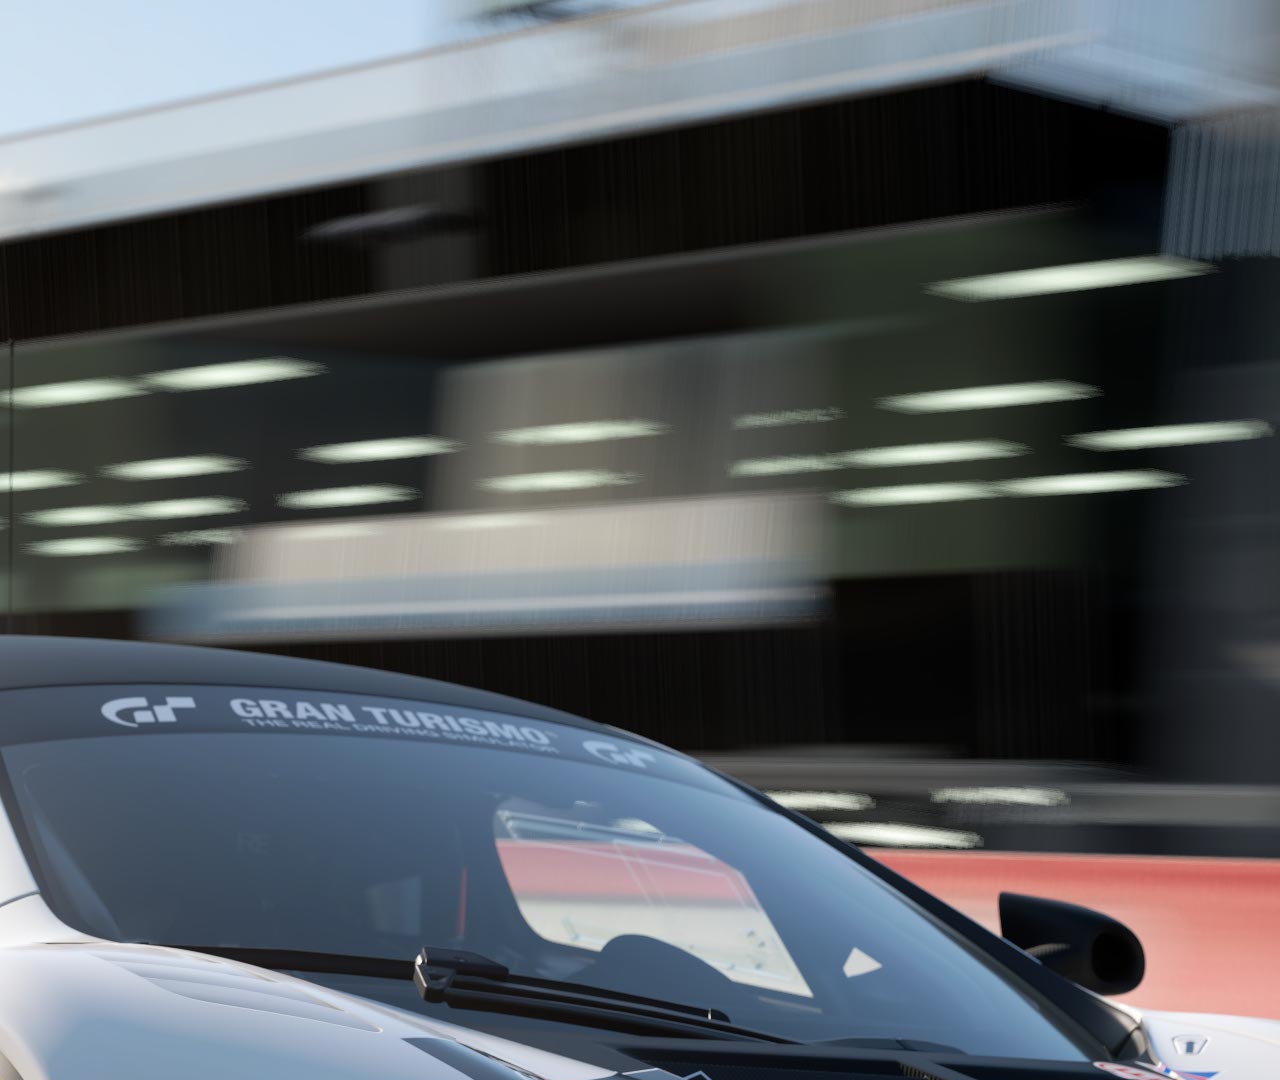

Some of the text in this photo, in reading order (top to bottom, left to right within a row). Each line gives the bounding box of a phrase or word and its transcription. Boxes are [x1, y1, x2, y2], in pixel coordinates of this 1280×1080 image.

[230, 697, 356, 723] GRAN
[241, 718, 561, 755] THE REAL DRIVING SIMULATOR
